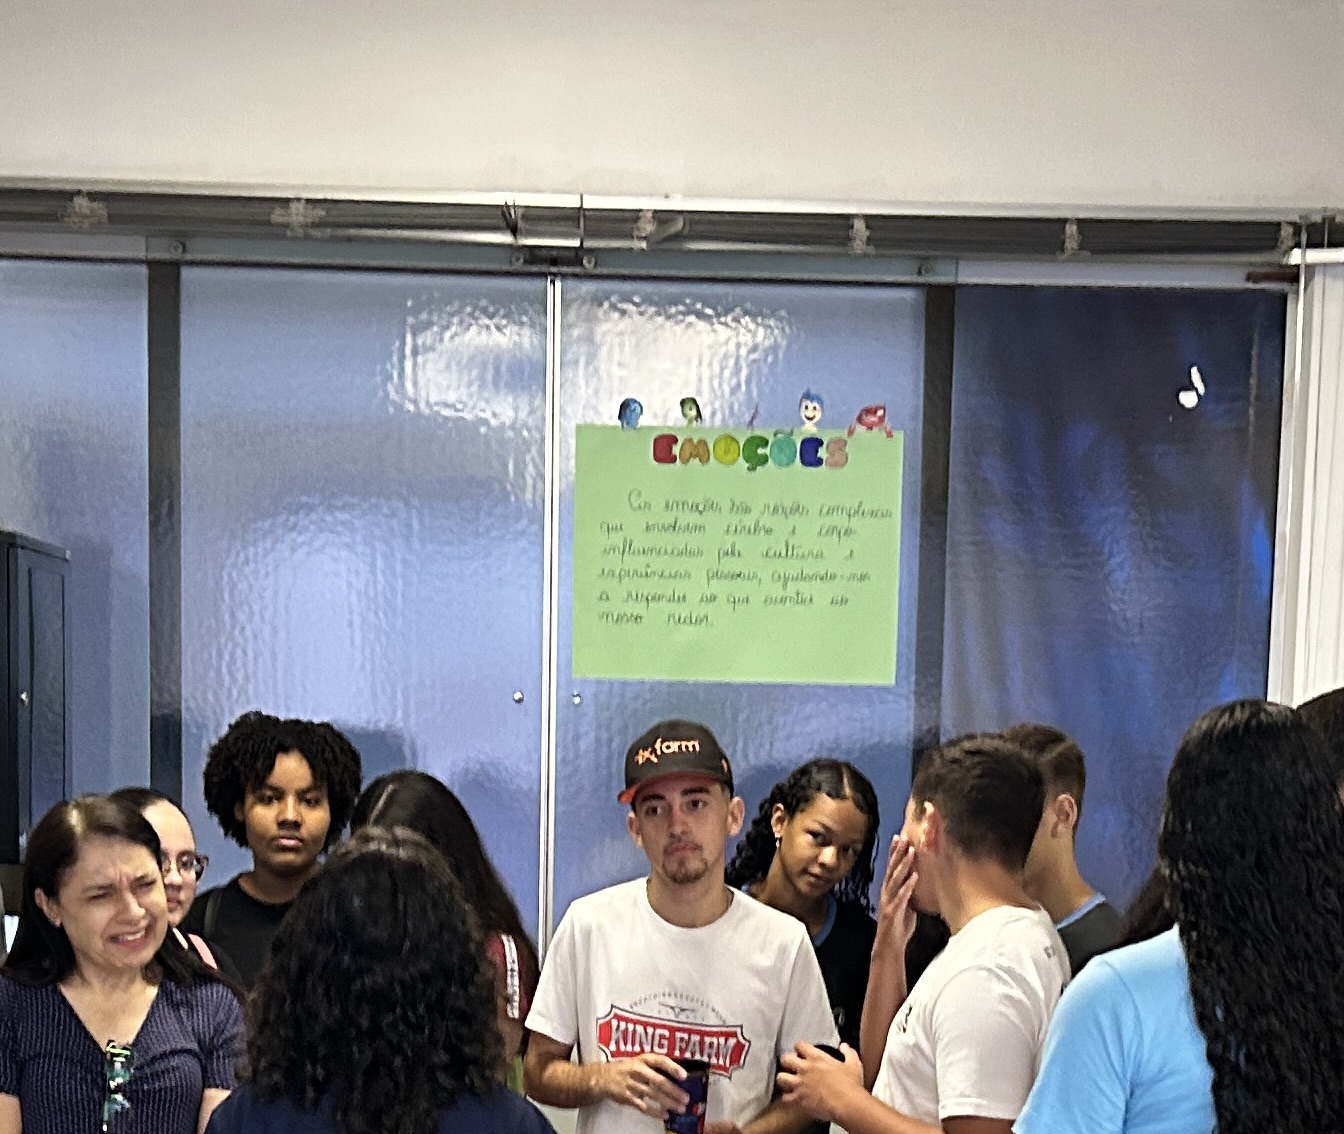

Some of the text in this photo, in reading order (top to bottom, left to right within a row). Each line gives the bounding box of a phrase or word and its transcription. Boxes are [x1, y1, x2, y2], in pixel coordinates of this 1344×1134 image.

[652, 428, 849, 473] EMOÇÕES
[608, 1018, 737, 1068] KING FARM
